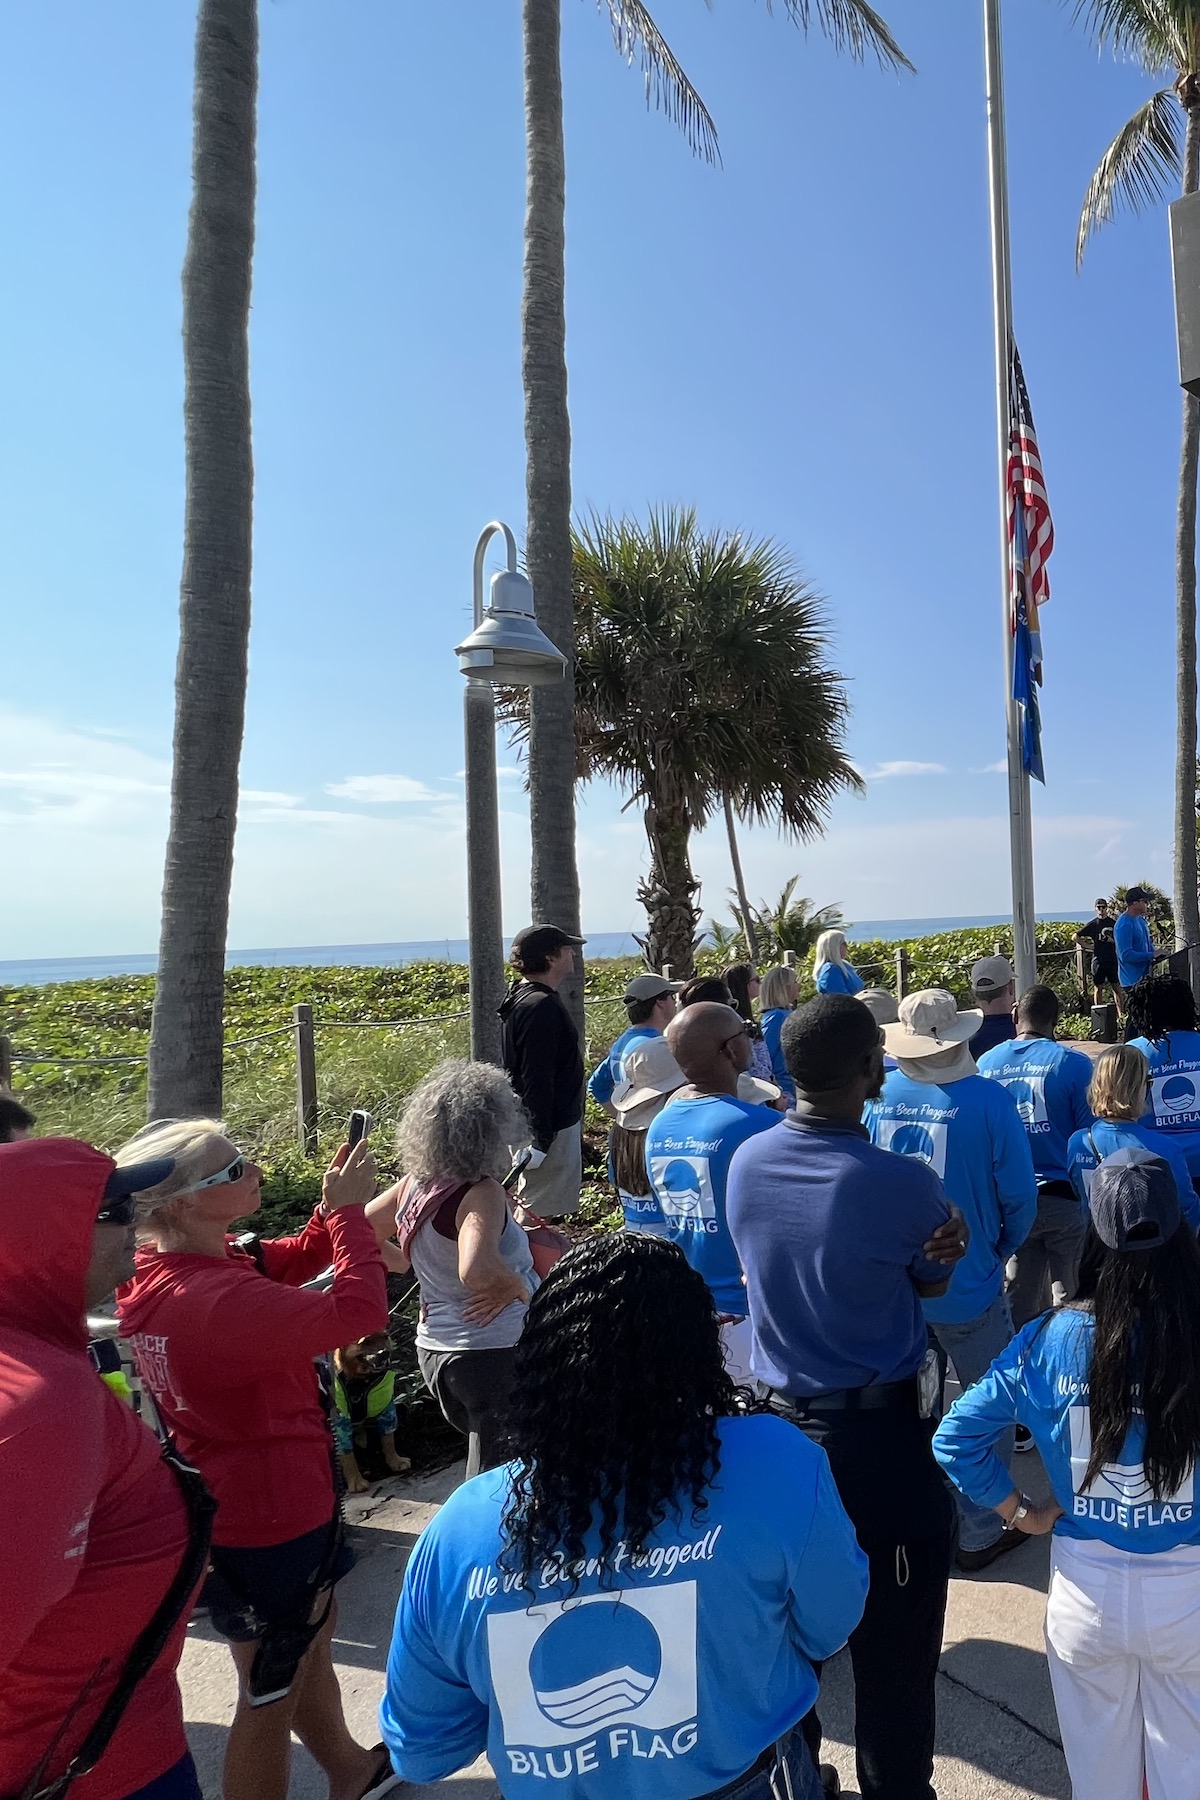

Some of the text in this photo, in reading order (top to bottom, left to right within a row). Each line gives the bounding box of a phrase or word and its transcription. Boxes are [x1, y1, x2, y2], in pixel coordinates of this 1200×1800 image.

[896, 1102, 919, 1116] Been
[920, 1103, 960, 1121] Flagged!
[1023, 1122, 1051, 1134] FLAG
[1155, 1115, 1181, 1127] BLUE
[635, 1201, 657, 1213] LAG
[687, 1217, 718, 1234] FLAG
[1073, 1495, 1193, 1529] BLUE FLAG
[506, 1722, 698, 1780] BLUE FLAG
